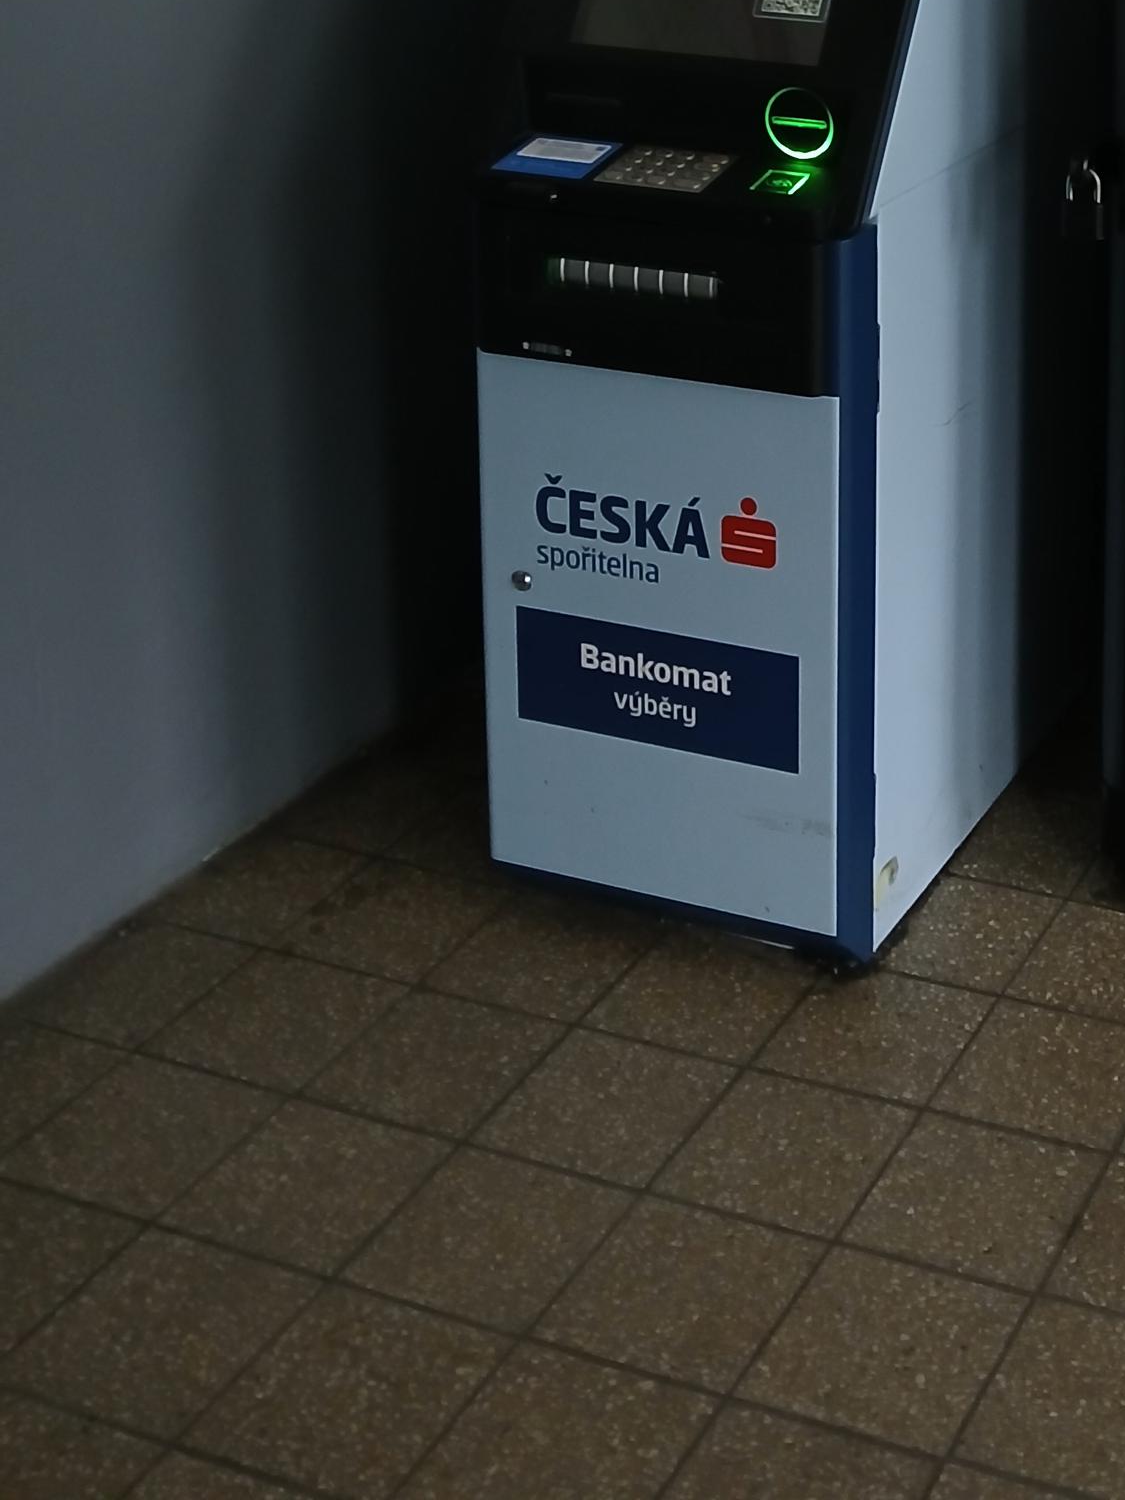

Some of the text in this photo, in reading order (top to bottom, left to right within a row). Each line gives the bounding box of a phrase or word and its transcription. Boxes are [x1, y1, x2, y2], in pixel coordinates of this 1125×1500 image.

[536, 473, 710, 559] ČESKÁ
[537, 545, 659, 584] spořitelna
[580, 642, 732, 696] Bankomat
[613, 690, 697, 728] výběry
